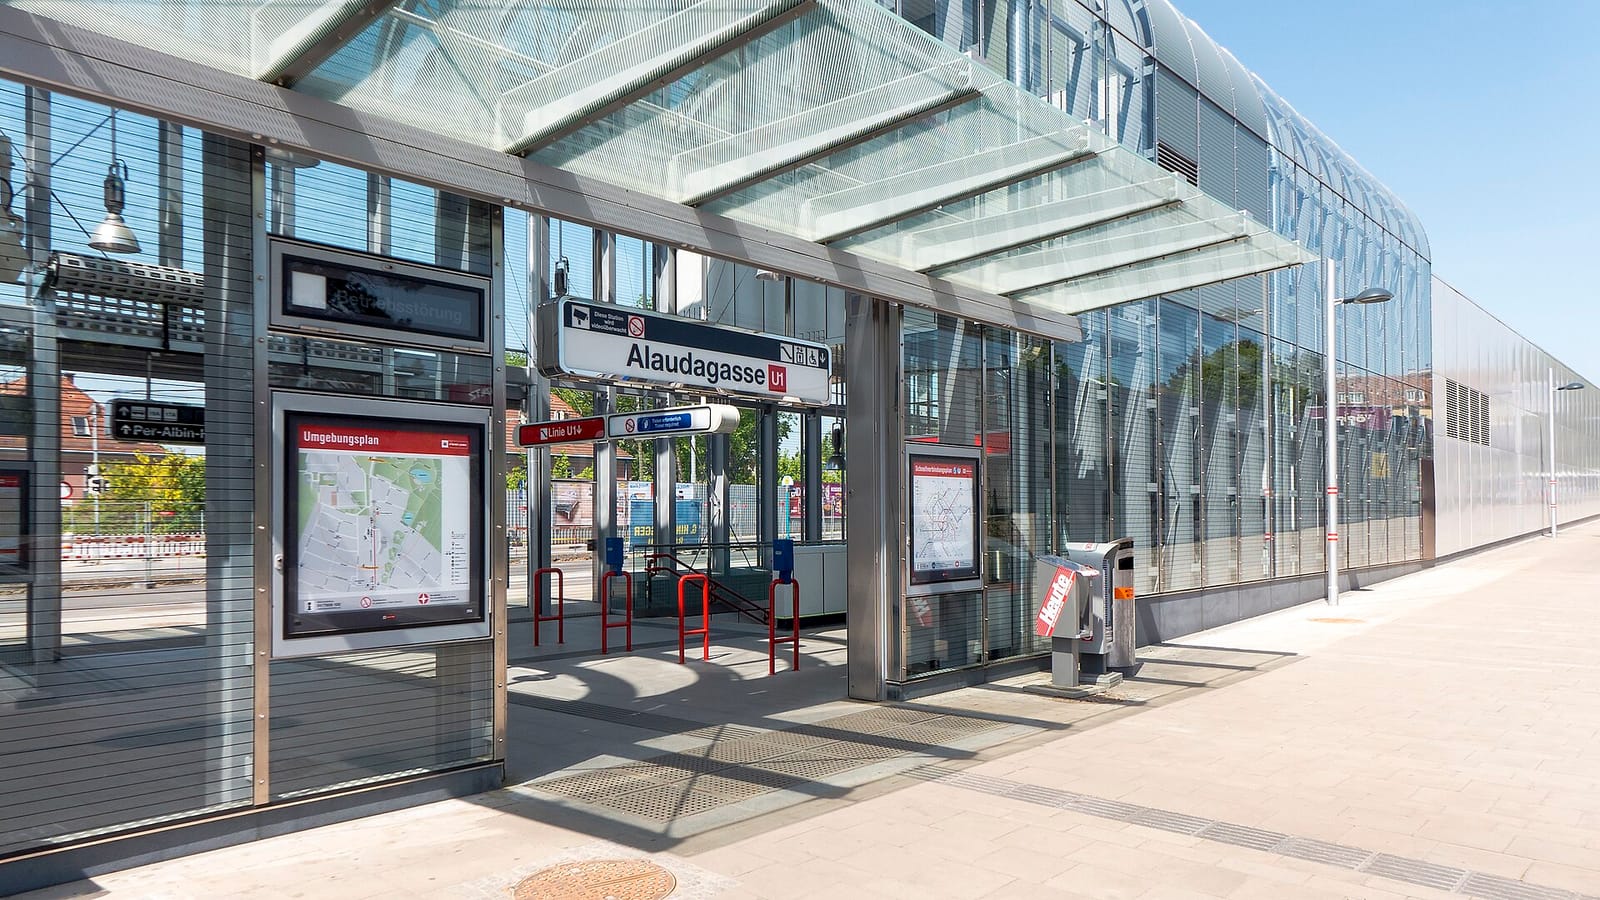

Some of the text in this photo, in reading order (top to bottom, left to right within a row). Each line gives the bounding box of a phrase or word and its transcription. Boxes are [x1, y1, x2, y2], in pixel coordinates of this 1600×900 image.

[626, 343, 766, 385] Alaudagasse
[771, 370, 784, 387] U1
[303, 430, 379, 447] Umgebungsplan
[548, 425, 578, 438] Linie U1
[1038, 573, 1069, 626] Heute
